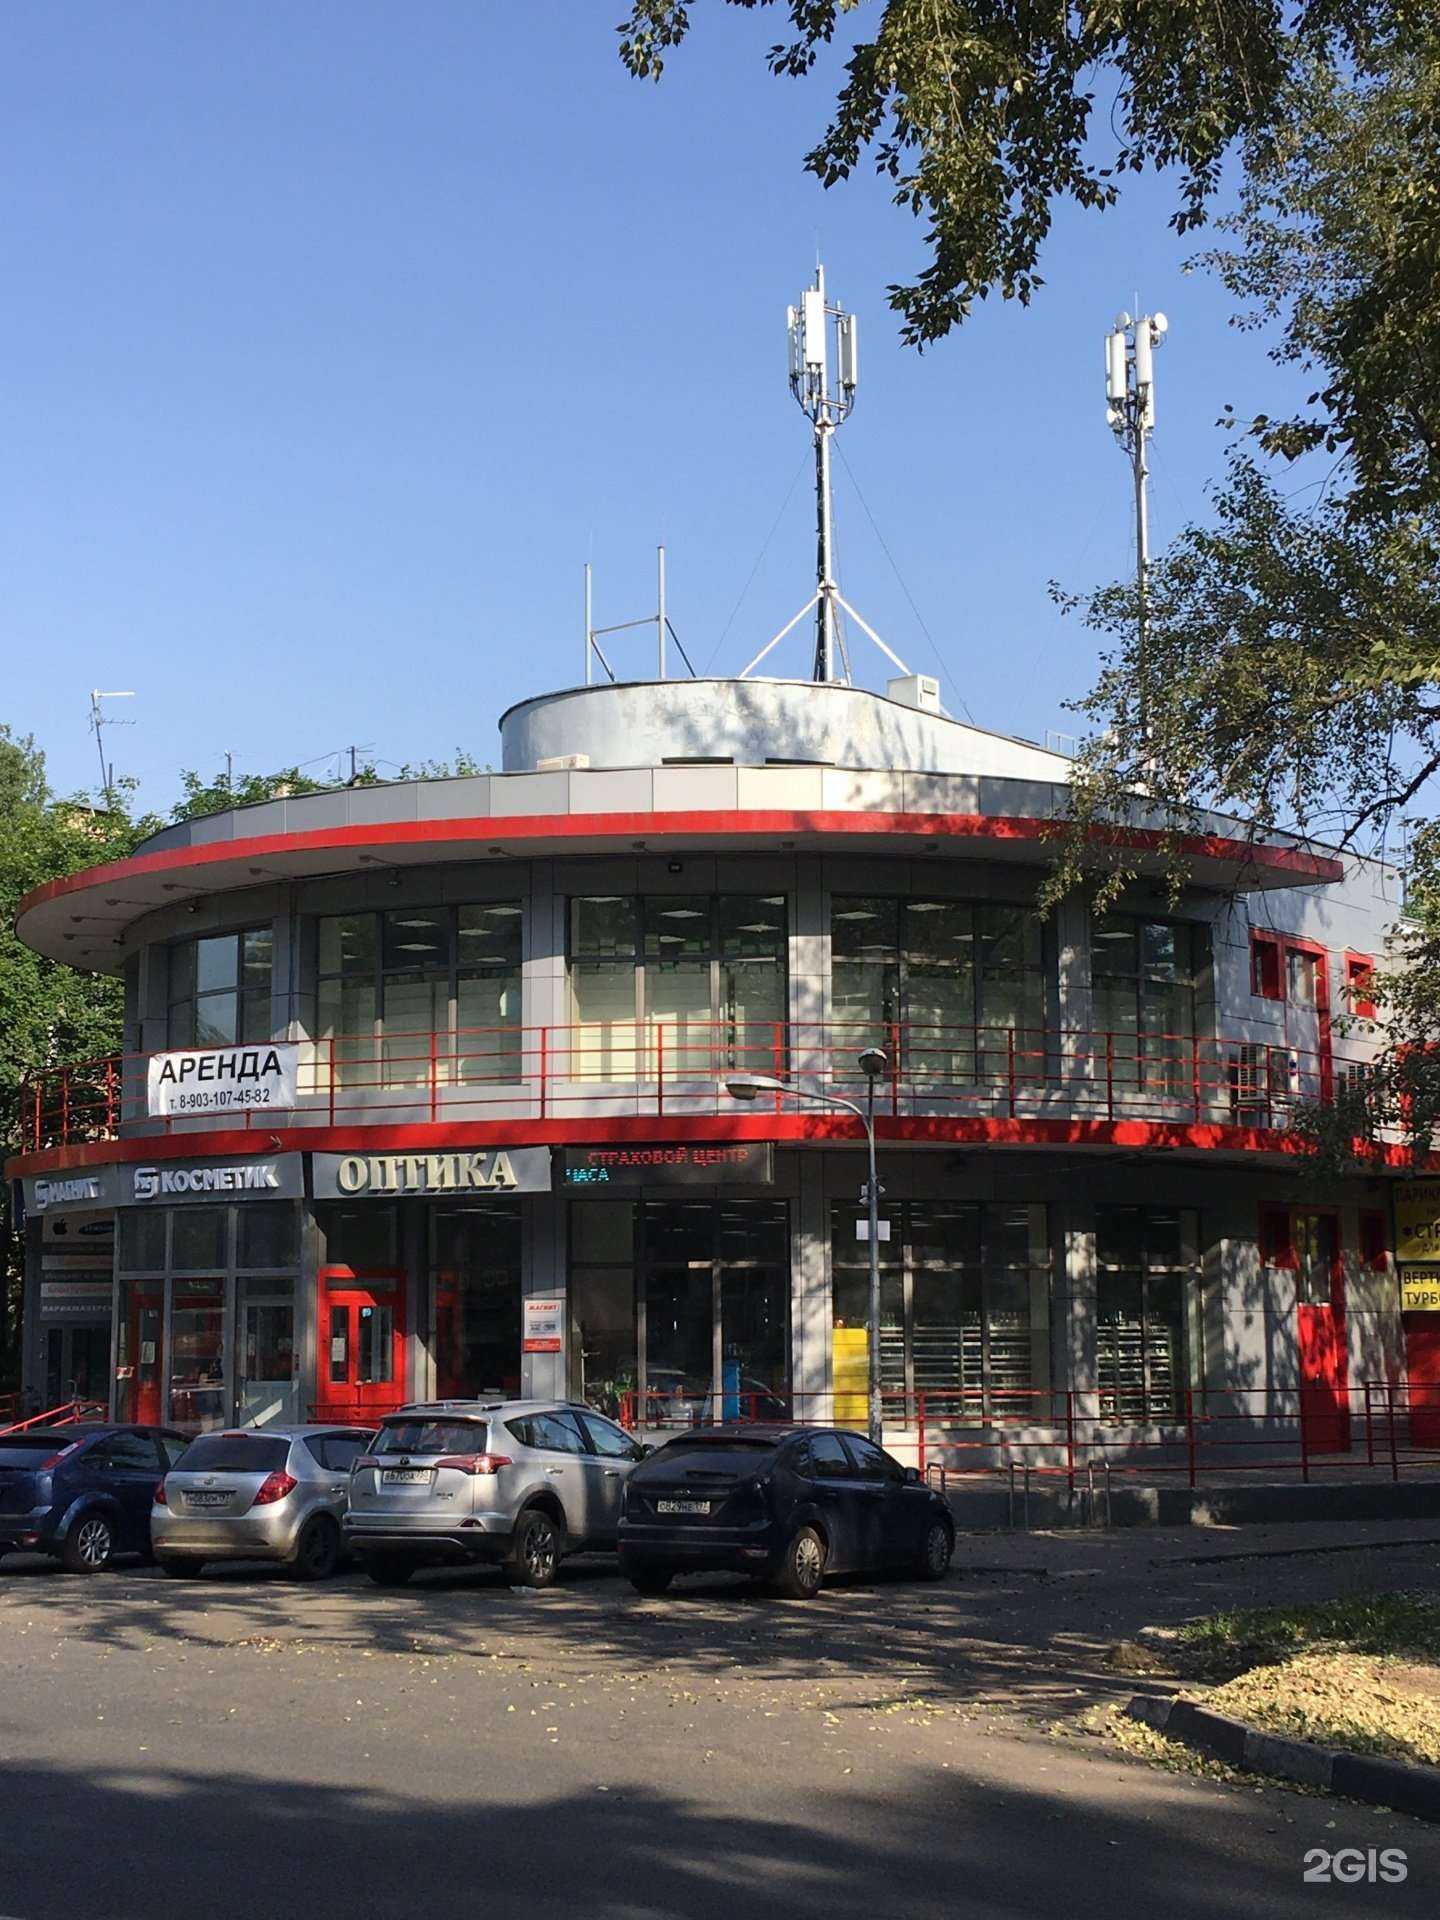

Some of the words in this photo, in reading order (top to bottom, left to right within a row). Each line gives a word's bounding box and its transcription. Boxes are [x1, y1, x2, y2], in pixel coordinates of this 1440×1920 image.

[159, 1050, 283, 1084] АРЕНДА
[170, 1098, 178, 1111] т.
[179, 1088, 271, 1110] 8-903-107-45-82
[587, 1146, 687, 1167] СТРАХОВОЙ
[692, 1148, 749, 1168] ЦЕНТР
[161, 1164, 280, 1194] КОСМЕТИК
[337, 1150, 519, 1194] ОПТИКА
[1403, 1291, 1440, 1305] ТУРБ
